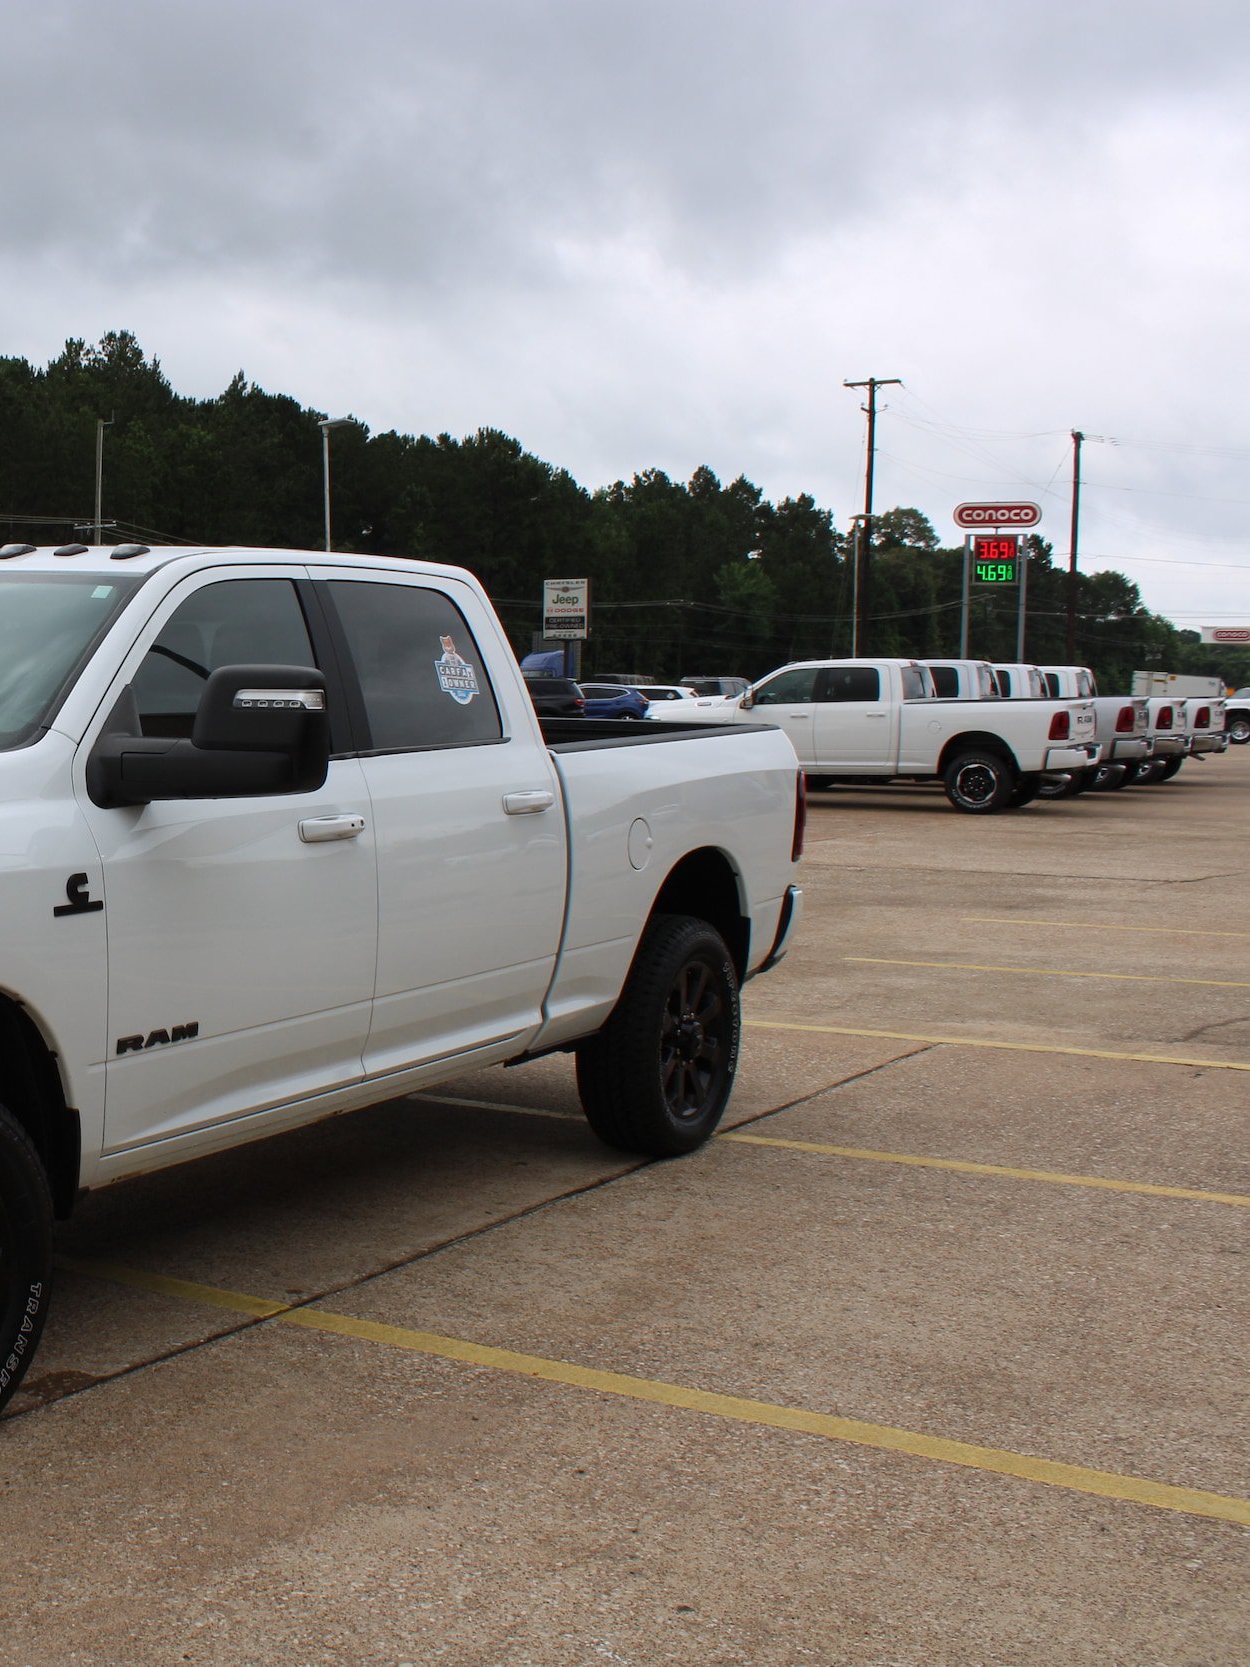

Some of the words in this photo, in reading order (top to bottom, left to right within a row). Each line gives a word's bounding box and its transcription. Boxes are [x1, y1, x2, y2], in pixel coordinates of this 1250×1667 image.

[552, 594, 579, 606] Jeep
[439, 666, 473, 678] CARFAX
[116, 1021, 199, 1055] RAM
